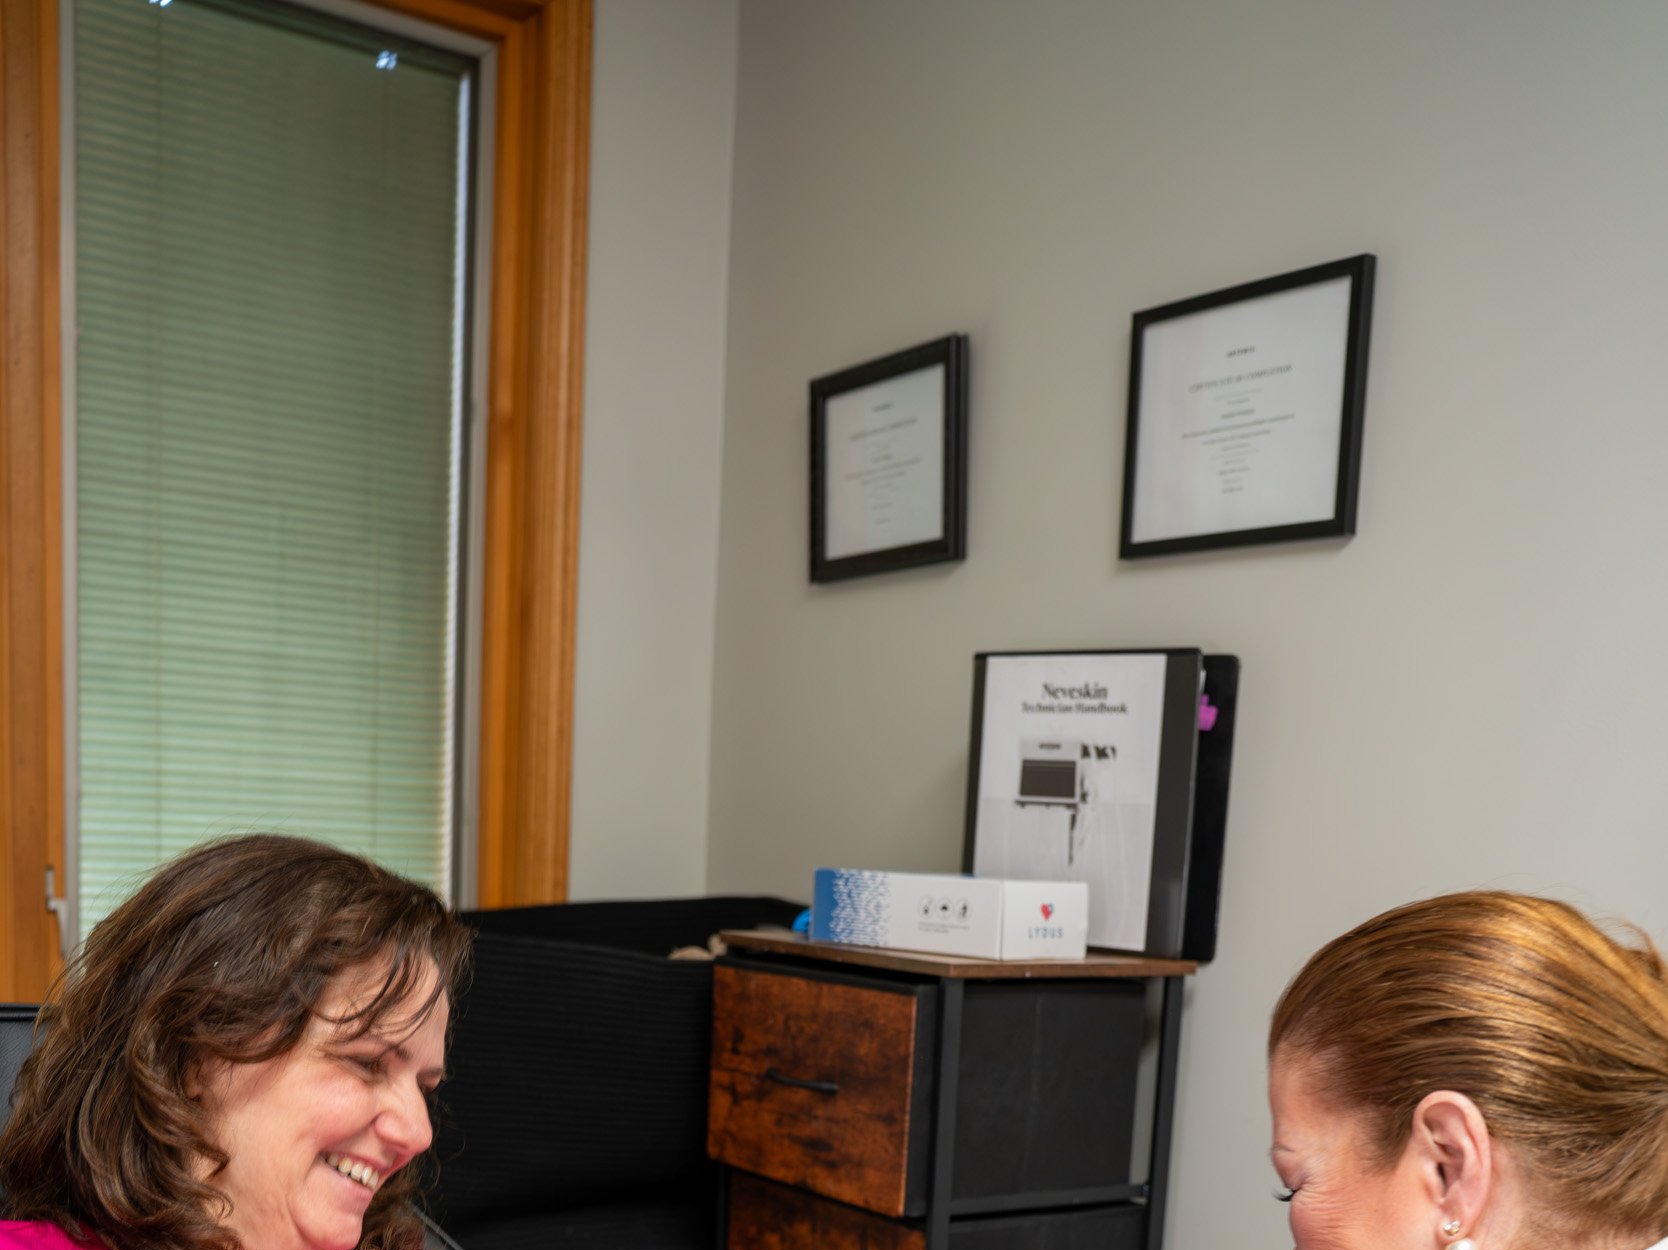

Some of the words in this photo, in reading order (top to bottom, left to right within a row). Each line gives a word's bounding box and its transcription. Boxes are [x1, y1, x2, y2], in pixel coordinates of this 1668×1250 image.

[1042, 682, 1108, 700] Neveskin
[1022, 702, 1073, 714] Technician
[1075, 702, 1127, 714] Handbook
[1028, 927, 1064, 939] LYDUS
